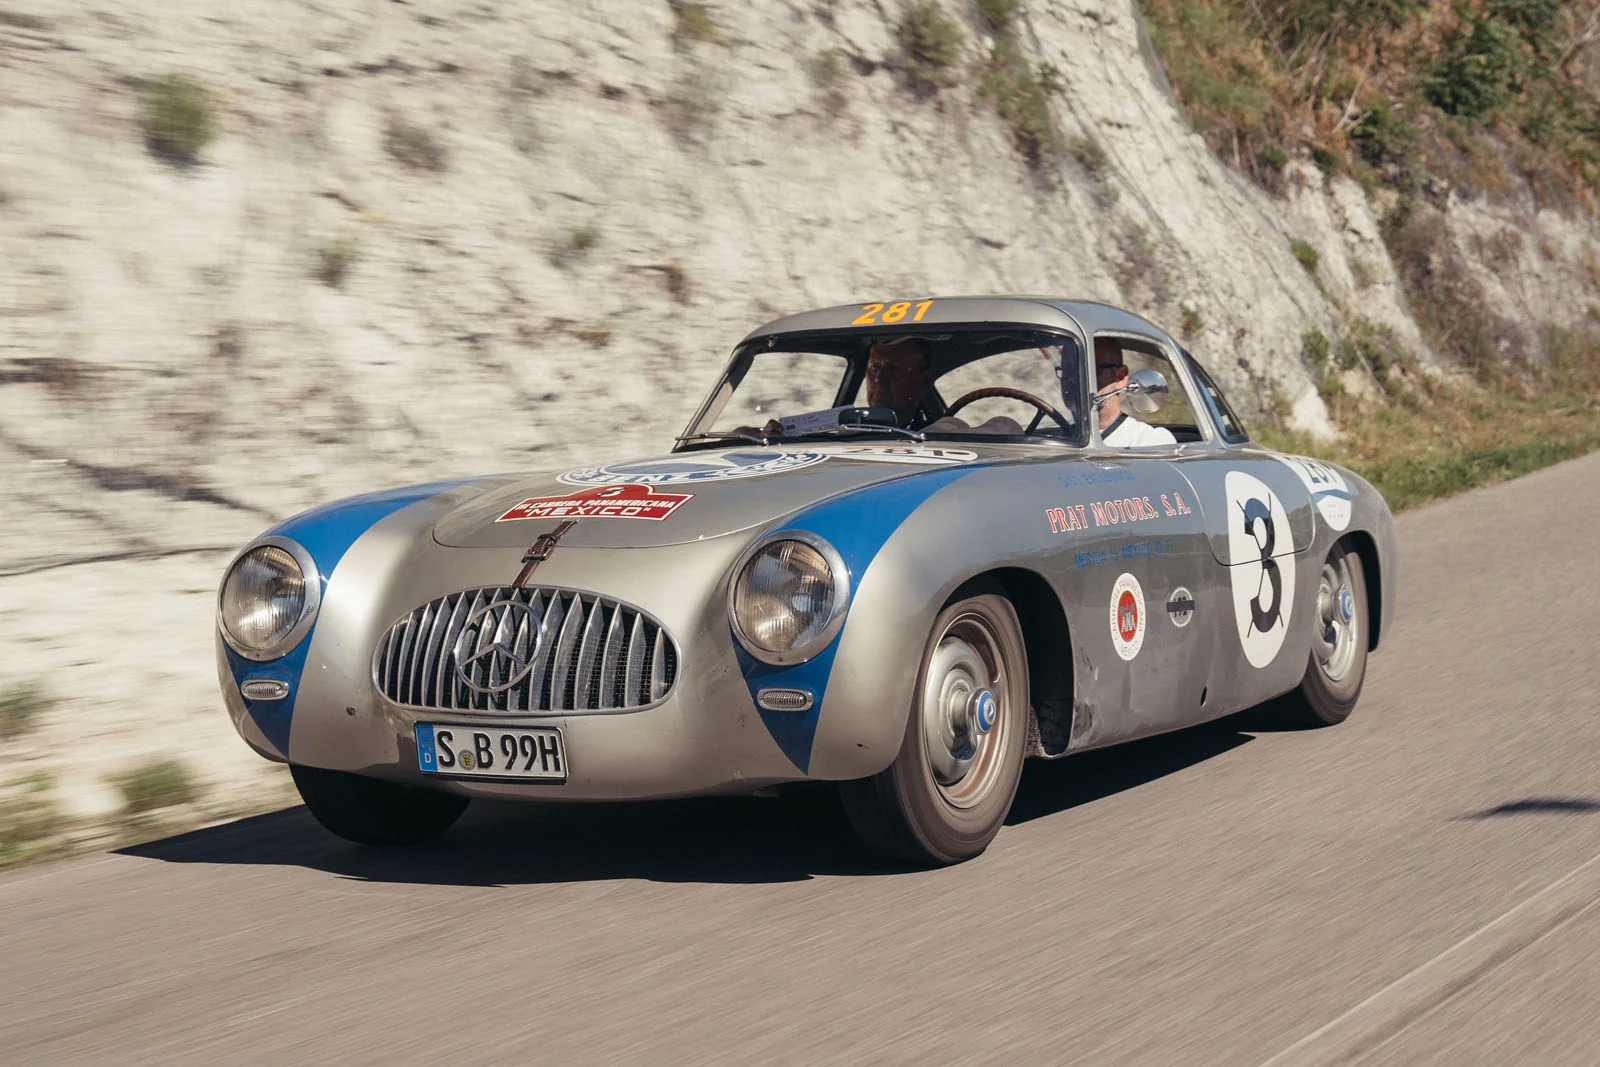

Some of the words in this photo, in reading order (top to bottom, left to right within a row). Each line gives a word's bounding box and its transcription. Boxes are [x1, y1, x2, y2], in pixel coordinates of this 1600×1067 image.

[851, 300, 934, 325] 281
[529, 500, 584, 509] CARRERA
[583, 499, 677, 509] PANAMERICANA
[1046, 504, 1089, 533] PRAT
[1161, 492, 1191, 517] S.A.
[1244, 498, 1283, 633] 3
[424, 752, 432, 764] D
[437, 730, 456, 768] S
[473, 732, 494, 769] B
[500, 733, 562, 772] 99H
